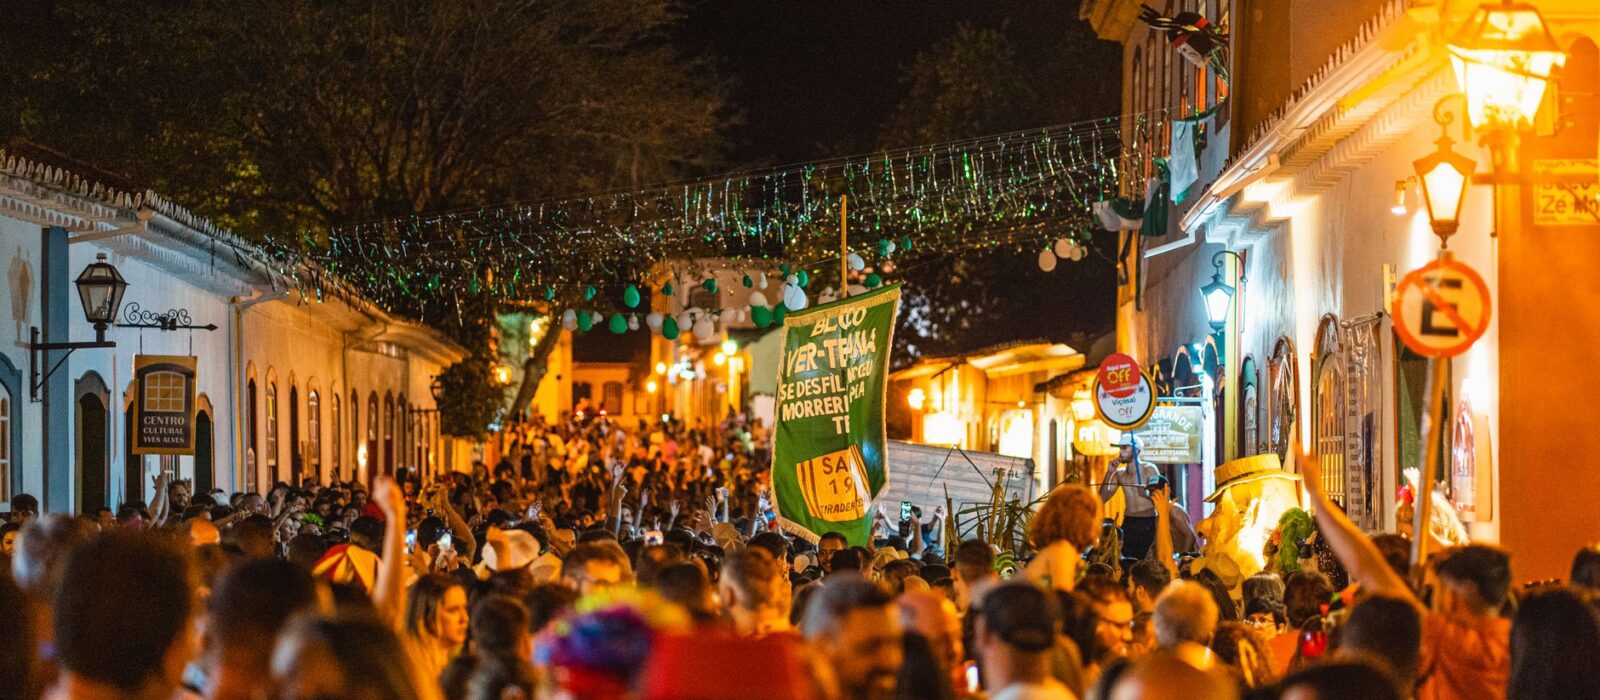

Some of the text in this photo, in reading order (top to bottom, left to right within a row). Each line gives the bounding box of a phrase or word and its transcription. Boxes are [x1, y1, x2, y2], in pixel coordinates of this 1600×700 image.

[1420, 277, 1462, 337] E
[780, 374, 848, 401] SE DESFIL
[144, 416, 185, 425] CENTRO
